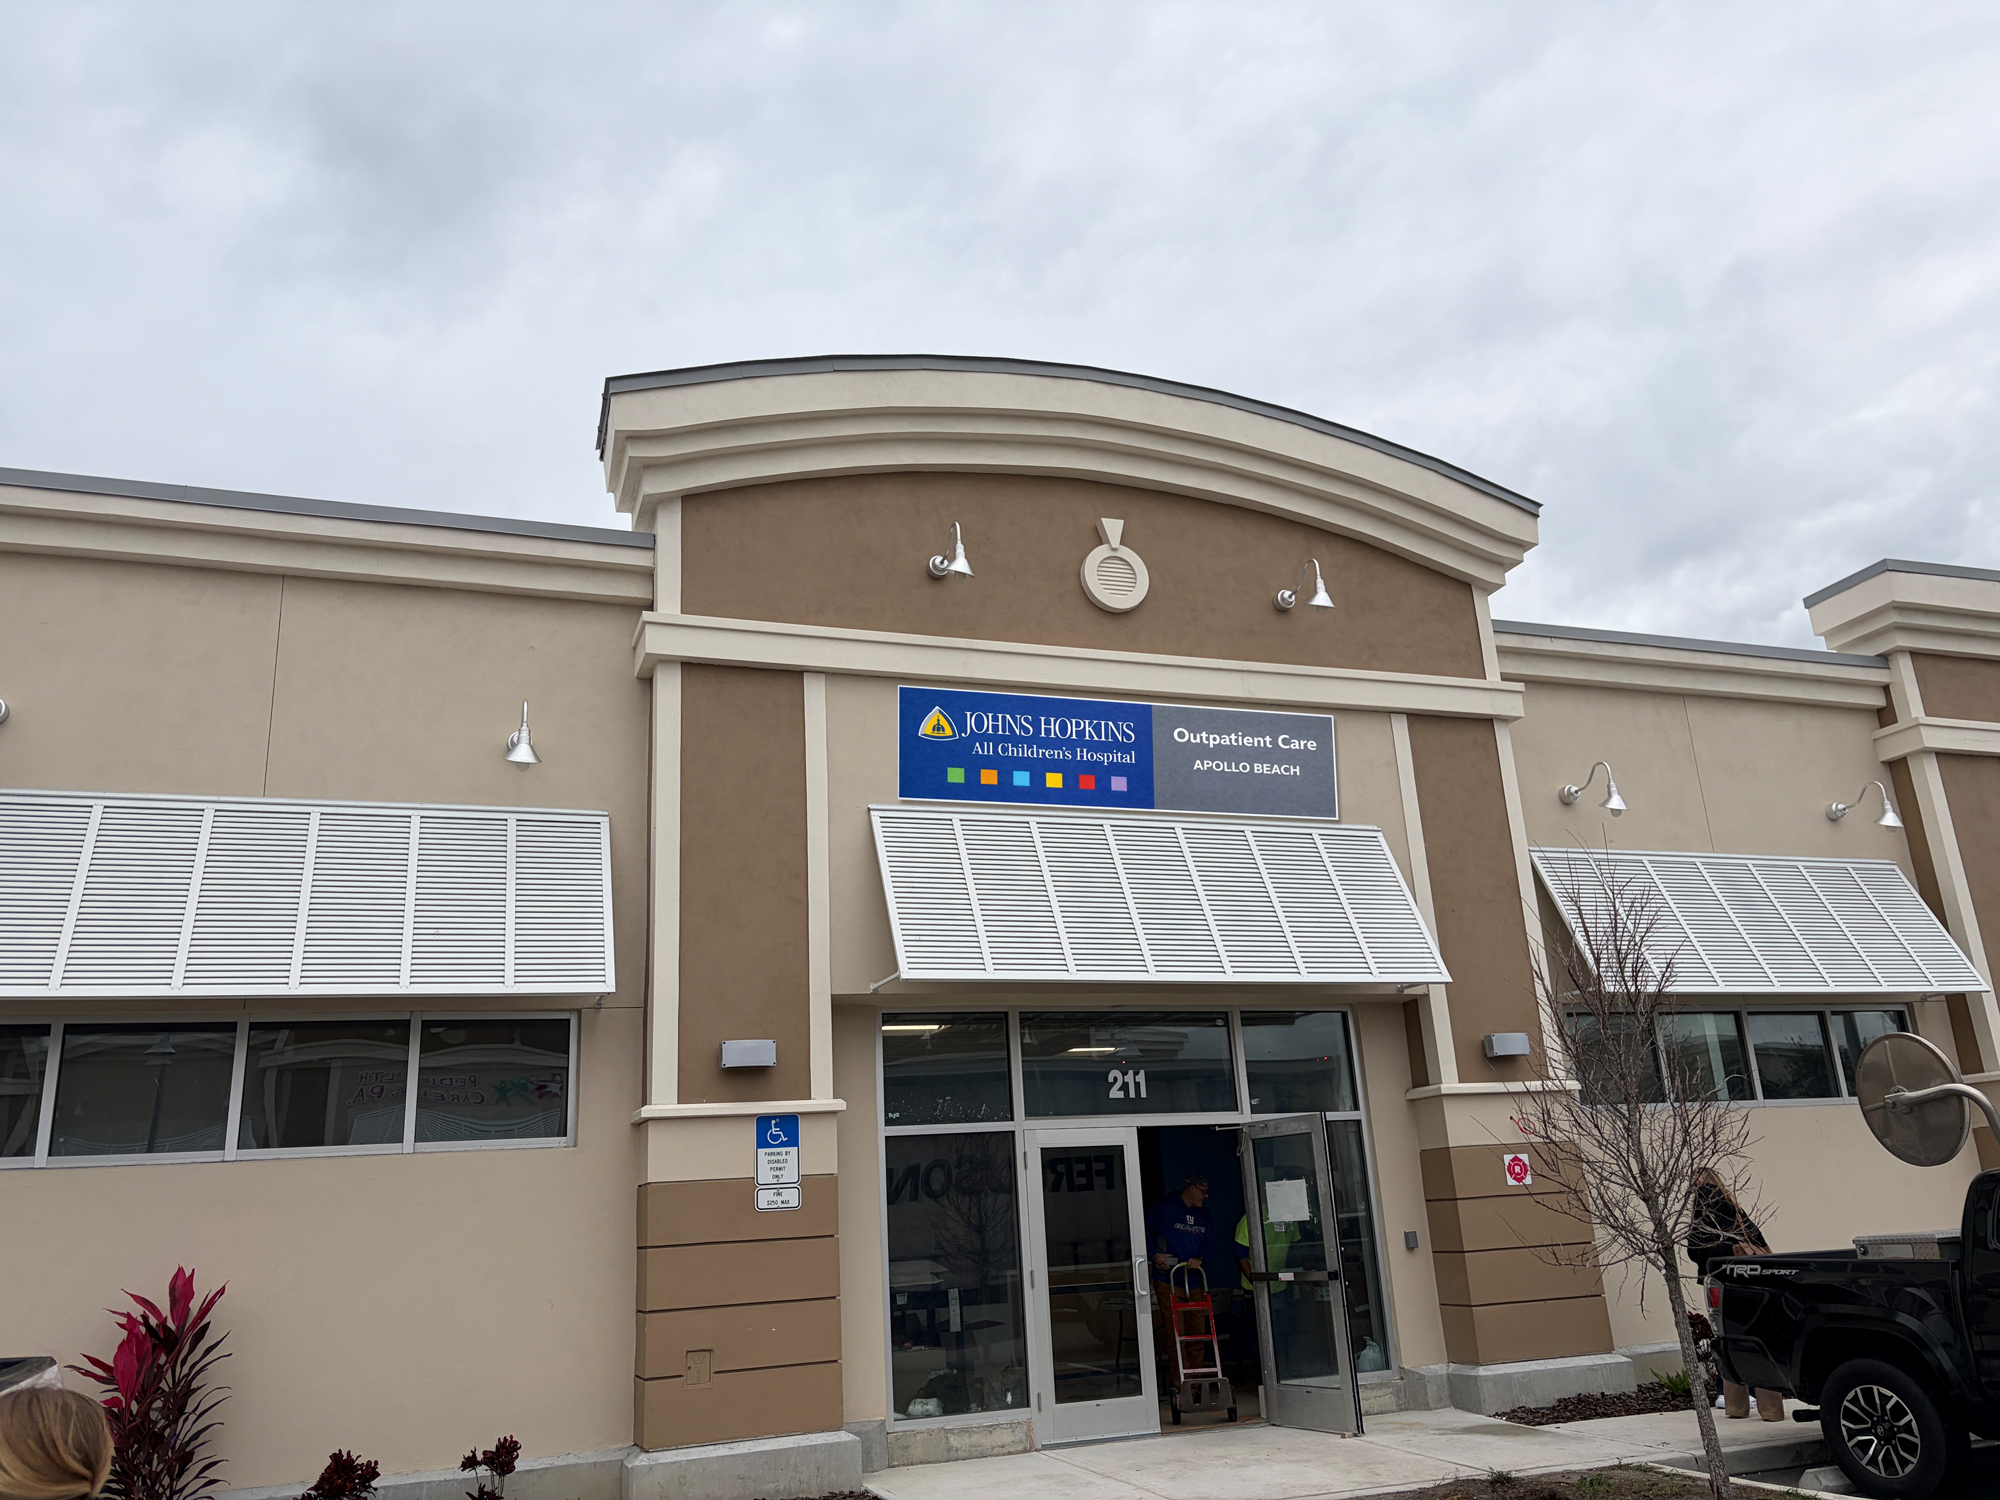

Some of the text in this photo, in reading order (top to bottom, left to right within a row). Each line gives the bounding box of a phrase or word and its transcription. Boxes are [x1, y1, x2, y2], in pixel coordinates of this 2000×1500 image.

[961, 711, 1136, 743] JOHNS HOPKINS
[1173, 727, 1317, 751] Outpatient Care
[971, 741, 994, 755] All
[1076, 748, 1136, 765] Hospital
[1193, 759, 1300, 776] APOLLO BEACH
[1108, 1069, 1147, 1098] 211
[1722, 1264, 1761, 1278] TRD
